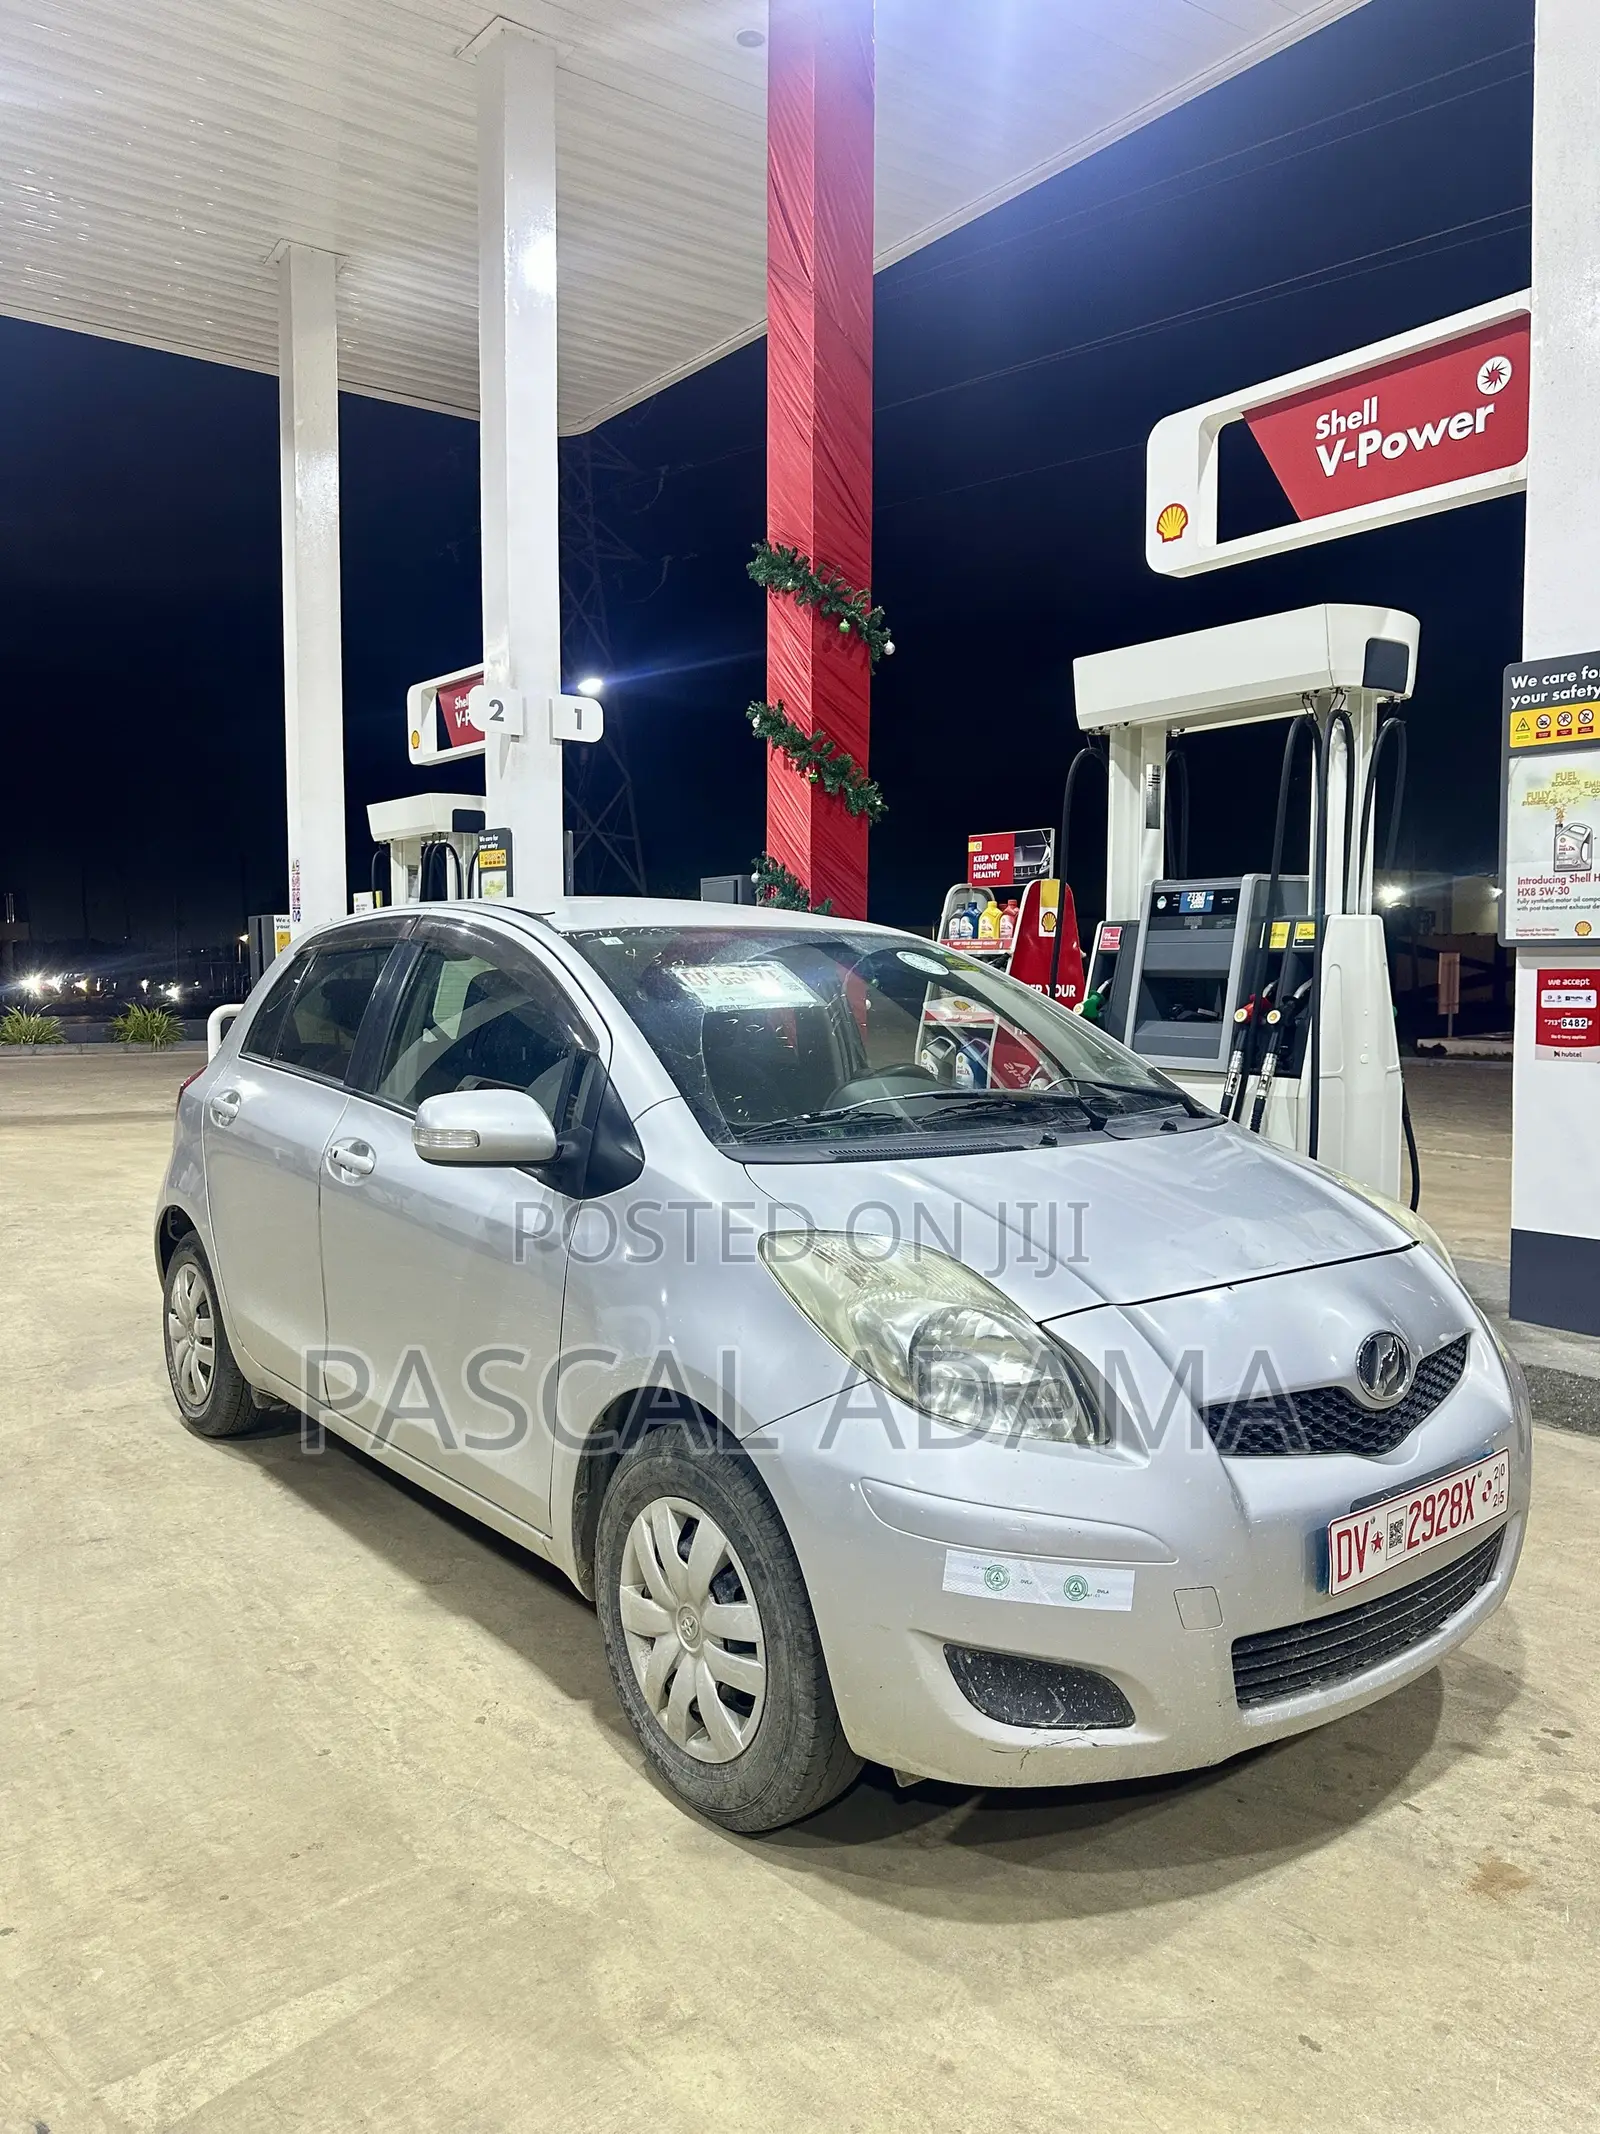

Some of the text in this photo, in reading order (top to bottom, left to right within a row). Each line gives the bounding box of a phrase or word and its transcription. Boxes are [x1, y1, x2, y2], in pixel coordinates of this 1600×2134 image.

[1315, 396, 1378, 440] Shell
[1315, 403, 1495, 478] V-Power
[1511, 665, 1600, 689] We care fo
[454, 694, 470, 710] Shel
[1510, 684, 1600, 710] your safety
[488, 699, 505, 722] 2
[574, 708, 583, 731] 1
[1555, 771, 1577, 781] FUEL
[1526, 790, 1551, 801] FULLY
[973, 853, 1010, 863] KEEP YOUR
[973, 863, 998, 871] ENGINE
[973, 871, 1001, 879] HEALTHY
[1517, 872, 1600, 886] Introducing Shell H
[1517, 886, 1570, 896] HX8 5W-30
[1531, 896, 1554, 905] synthetic
[1562, 978, 1590, 987] accept
[1493, 1463, 1506, 1480] 20
[1337, 1475, 1477, 1584] DV 2928X
